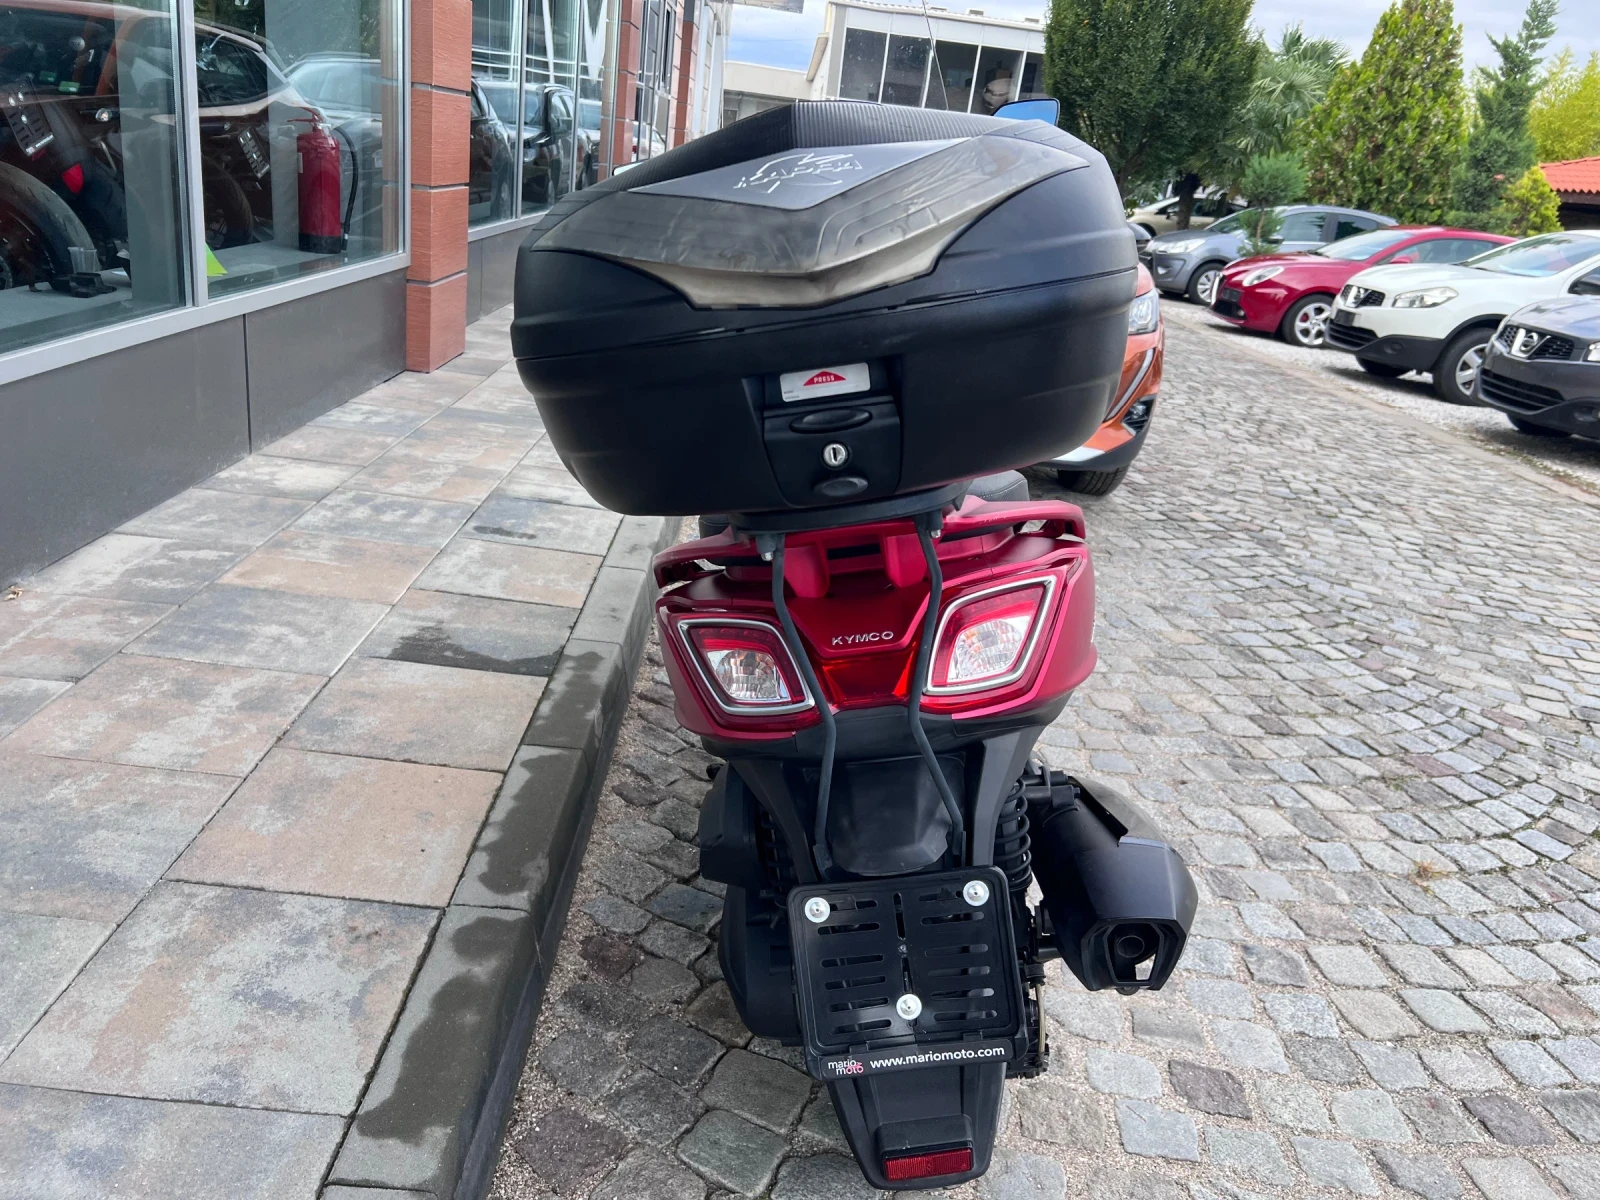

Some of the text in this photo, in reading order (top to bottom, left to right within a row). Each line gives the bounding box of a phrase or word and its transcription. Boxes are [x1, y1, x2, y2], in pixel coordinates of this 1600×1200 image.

[813, 374, 835, 384] PRESS
[831, 630, 894, 646] KYMCO
[869, 1046, 1005, 1069] www.mariomoto.com
[827, 1058, 857, 1070] mario
[835, 1065, 864, 1076] moto
